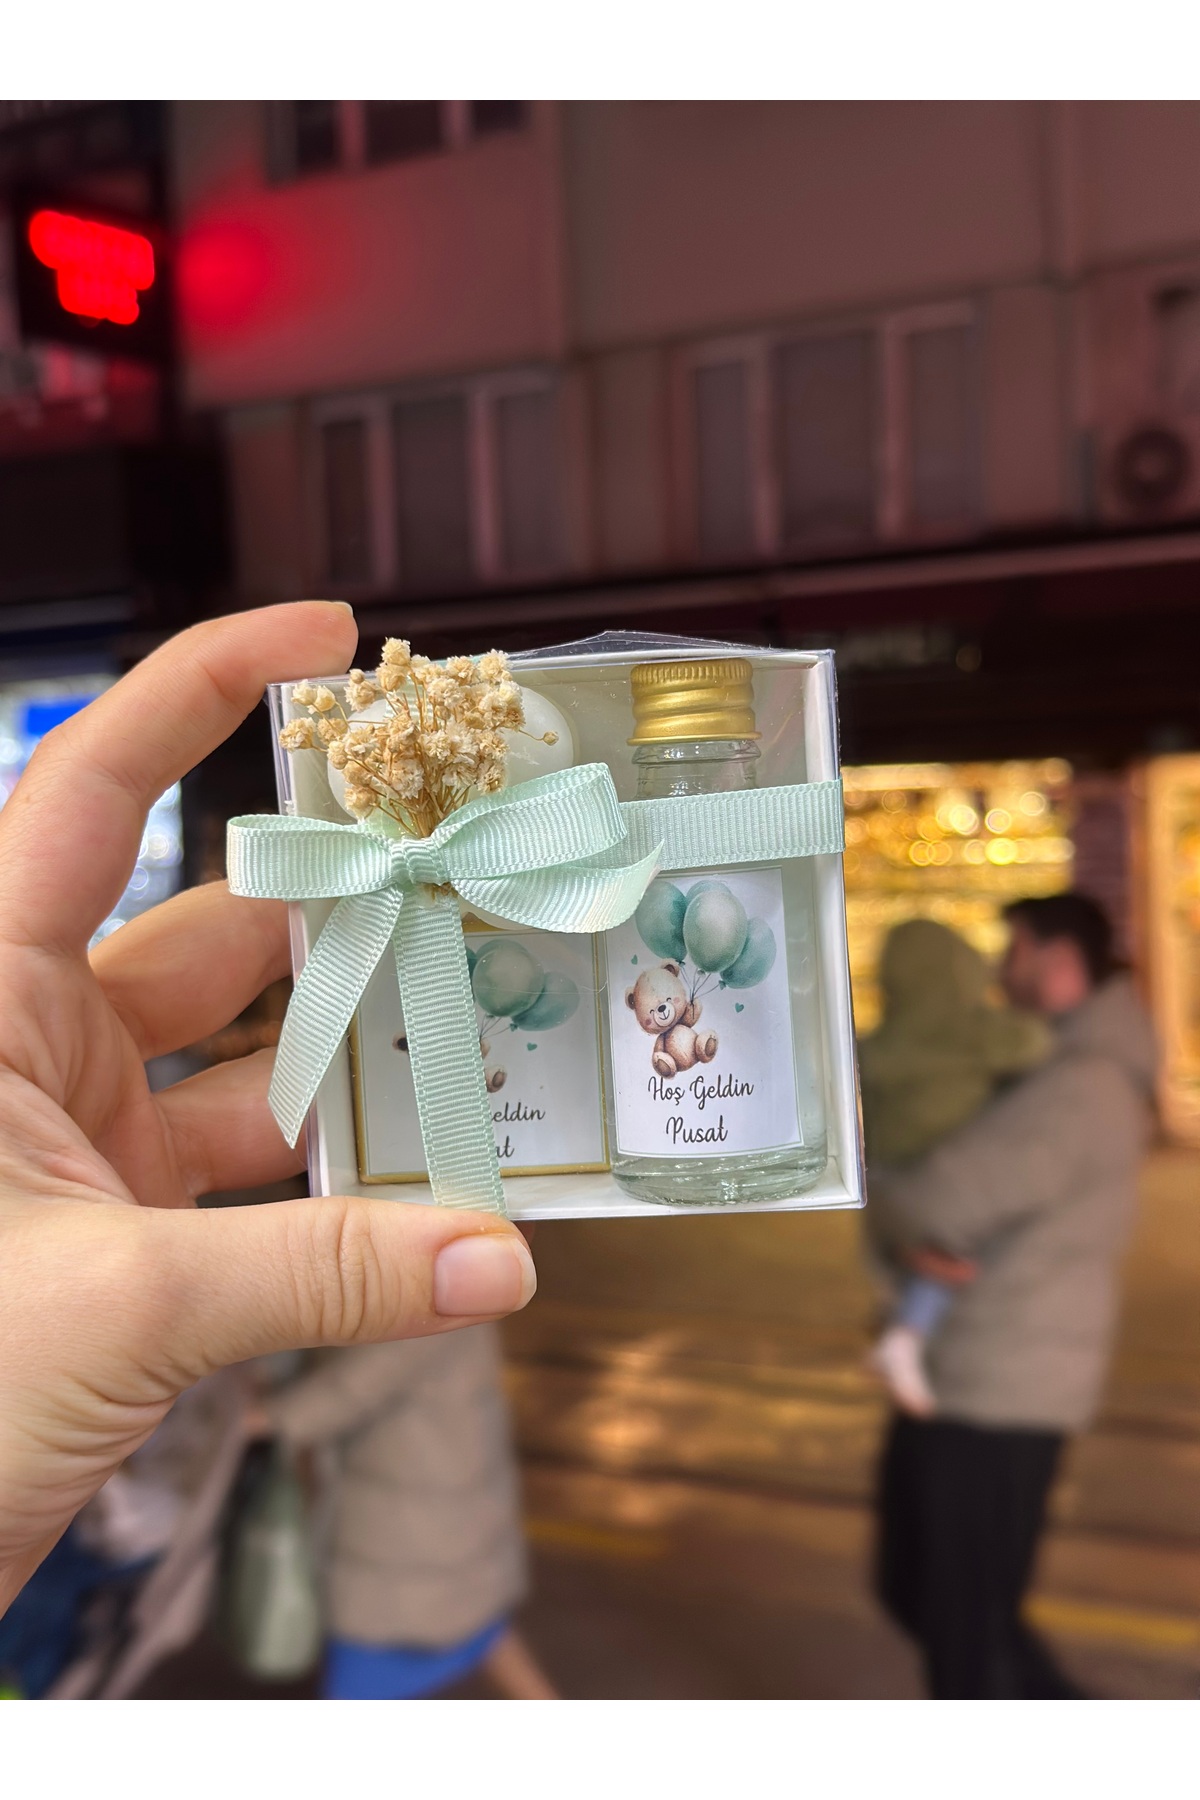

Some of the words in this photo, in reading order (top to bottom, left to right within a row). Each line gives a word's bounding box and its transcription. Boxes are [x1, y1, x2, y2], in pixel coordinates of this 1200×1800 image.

[647, 1075, 685, 1106] Hoş
[689, 1073, 754, 1110] Geldin
[491, 1101, 546, 1123] eldin
[666, 1115, 728, 1144] Pusat
